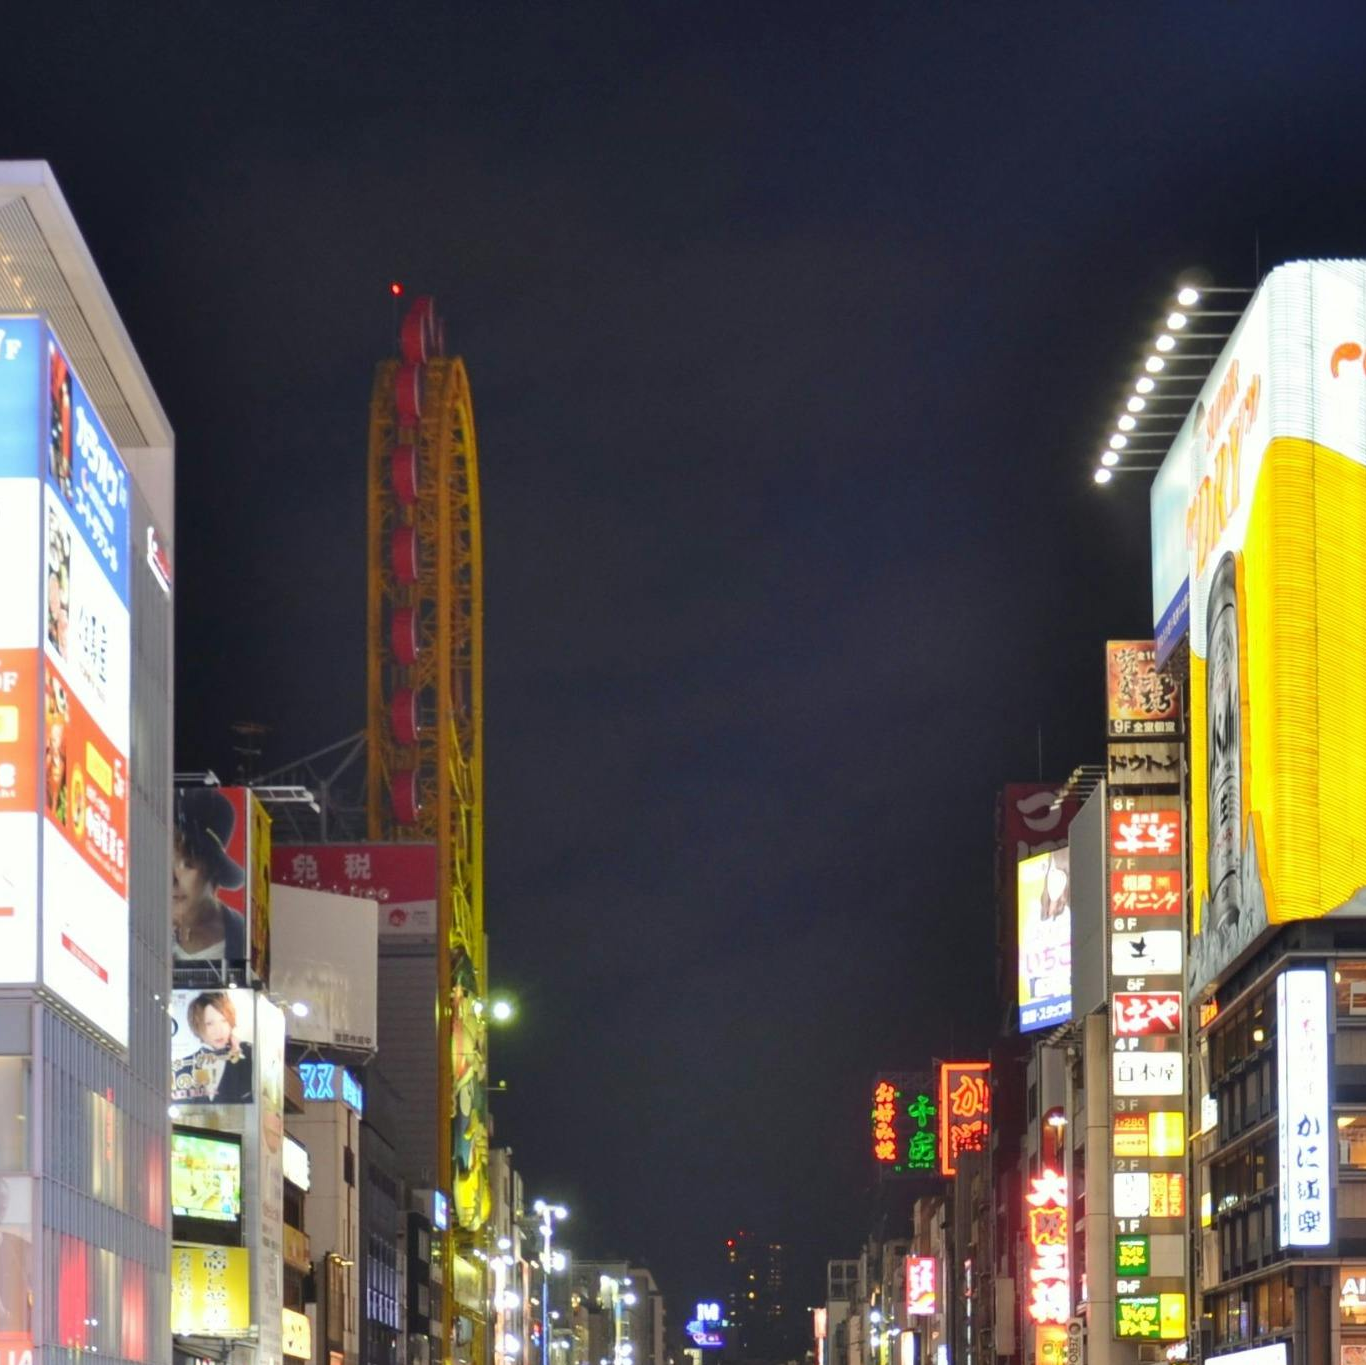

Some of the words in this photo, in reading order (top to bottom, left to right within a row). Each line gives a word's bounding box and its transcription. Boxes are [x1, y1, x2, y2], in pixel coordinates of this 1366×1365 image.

[1112, 799, 1136, 812] 8F
[292, 853, 372, 880] 免税
[1113, 917, 1138, 931] 6F
[1126, 977, 1146, 991] 5F
[1114, 1037, 1140, 1051] 4F
[1117, 1098, 1139, 1112] 3F
[1117, 1159, 1140, 1173] 2F
[1295, 1111, 1322, 1236] かに道楽
[1117, 1219, 1141, 1232] 1F
